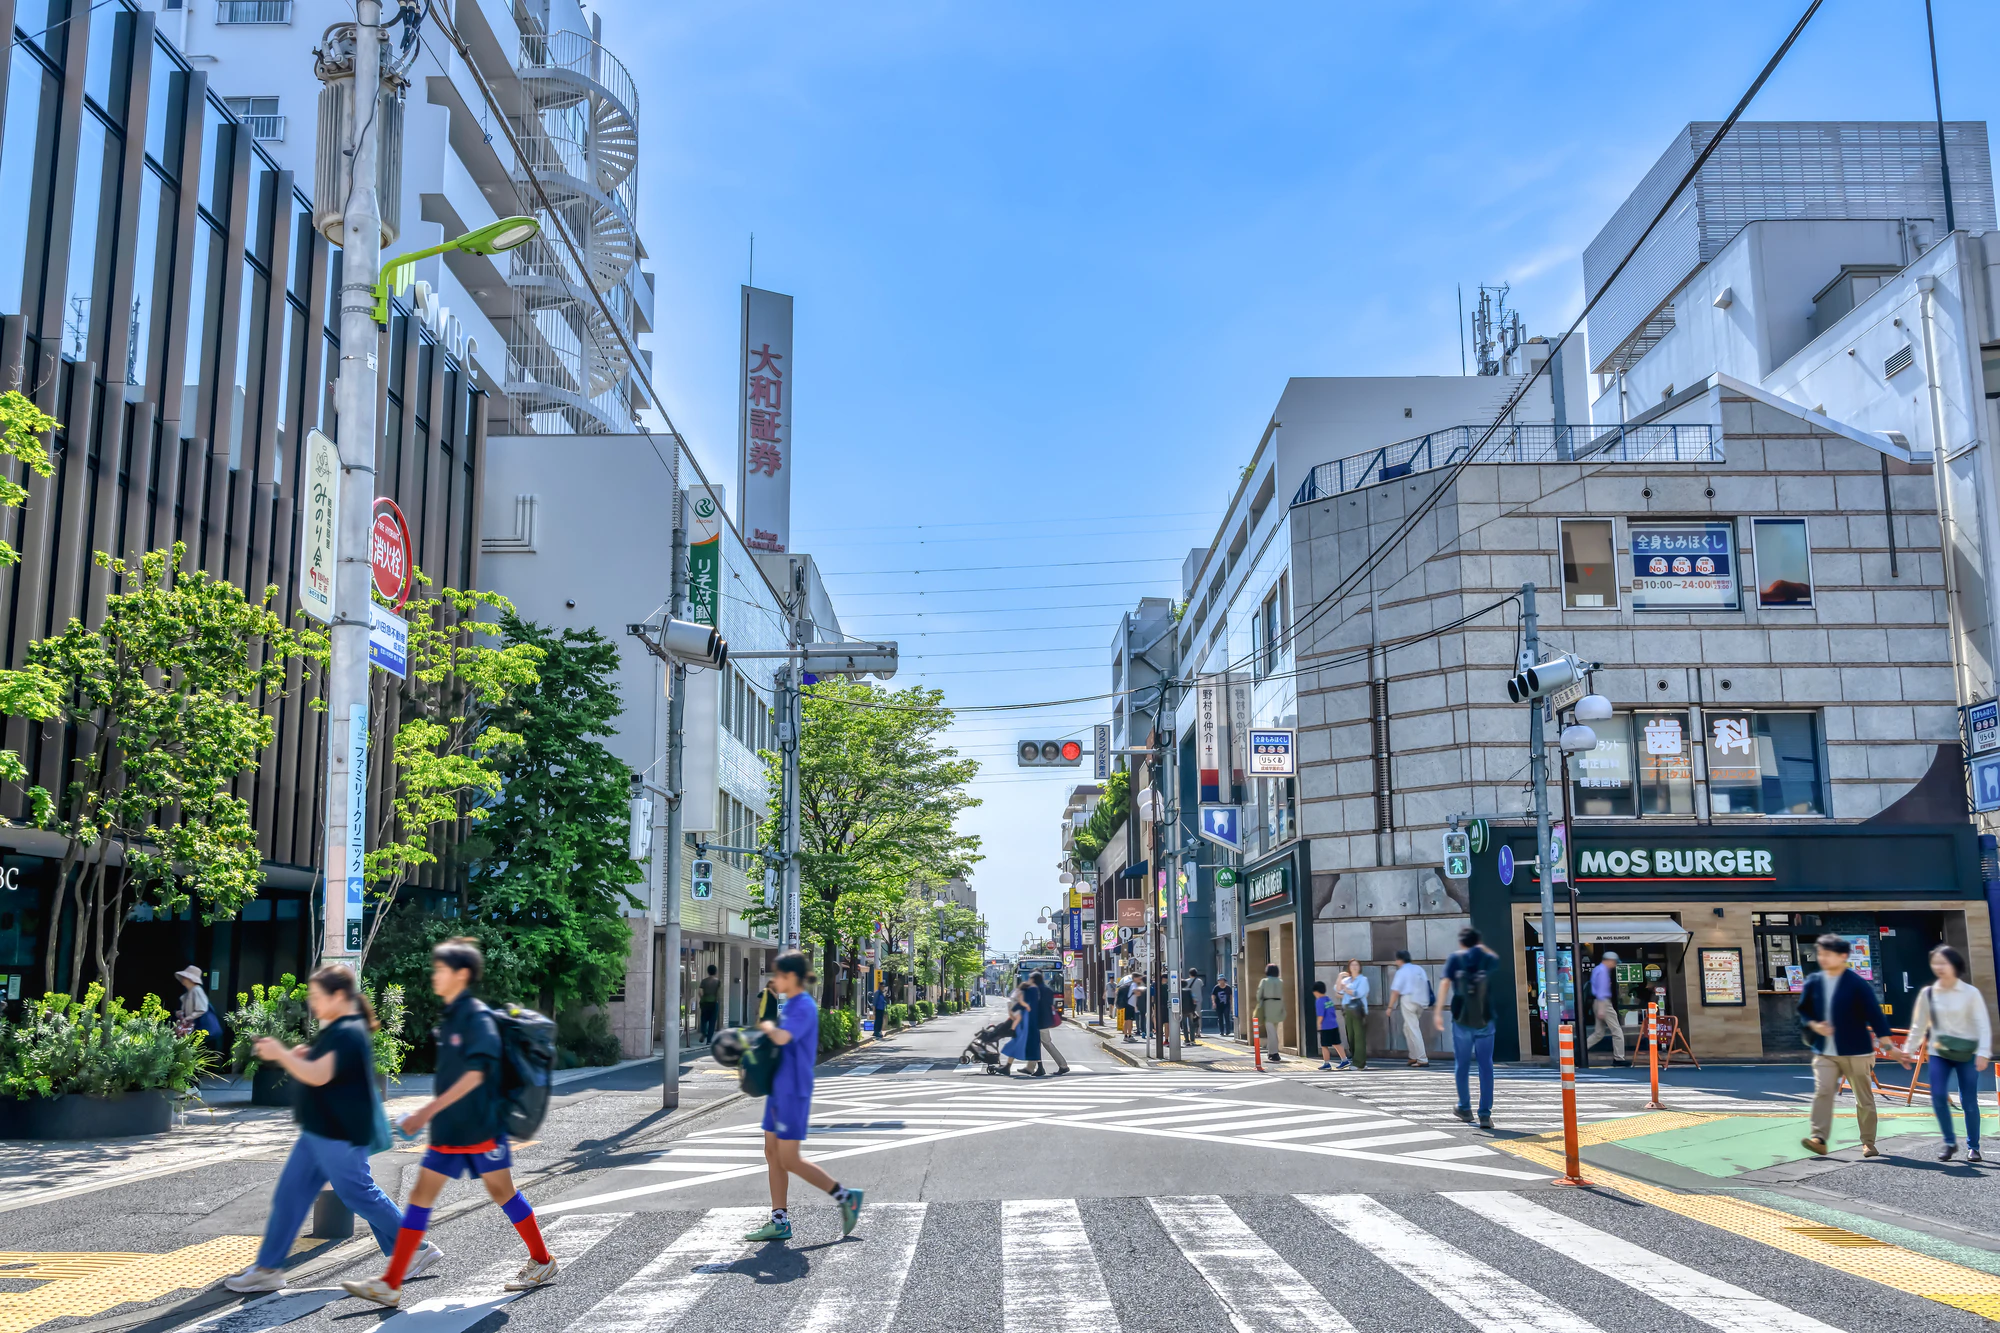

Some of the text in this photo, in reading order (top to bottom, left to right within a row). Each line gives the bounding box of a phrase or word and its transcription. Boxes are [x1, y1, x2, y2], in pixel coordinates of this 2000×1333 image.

[415, 280, 479, 380] SMBC
[749, 343, 783, 478] 大和証券
[313, 482, 328, 568] みのり会
[753, 528, 778, 542] Daiwa
[1636, 534, 1724, 550] 全身もみほぐし
[746, 537, 786, 554] Securities
[374, 533, 401, 579] 消火栓
[1649, 565, 1668, 573] No.1
[1672, 565, 1692, 573] No.1
[1695, 565, 1715, 573] No.1
[375, 618, 406, 645] 小田急不動産
[1980, 732, 1995, 741] りらくる
[1261, 756, 1283, 764] りらくる
[1647, 769, 1691, 779] デンタル
[1711, 769, 1756, 779] クリニック
[352, 746, 365, 873] ファミリークリニック
[1580, 849, 1773, 873] MOS BURGER
